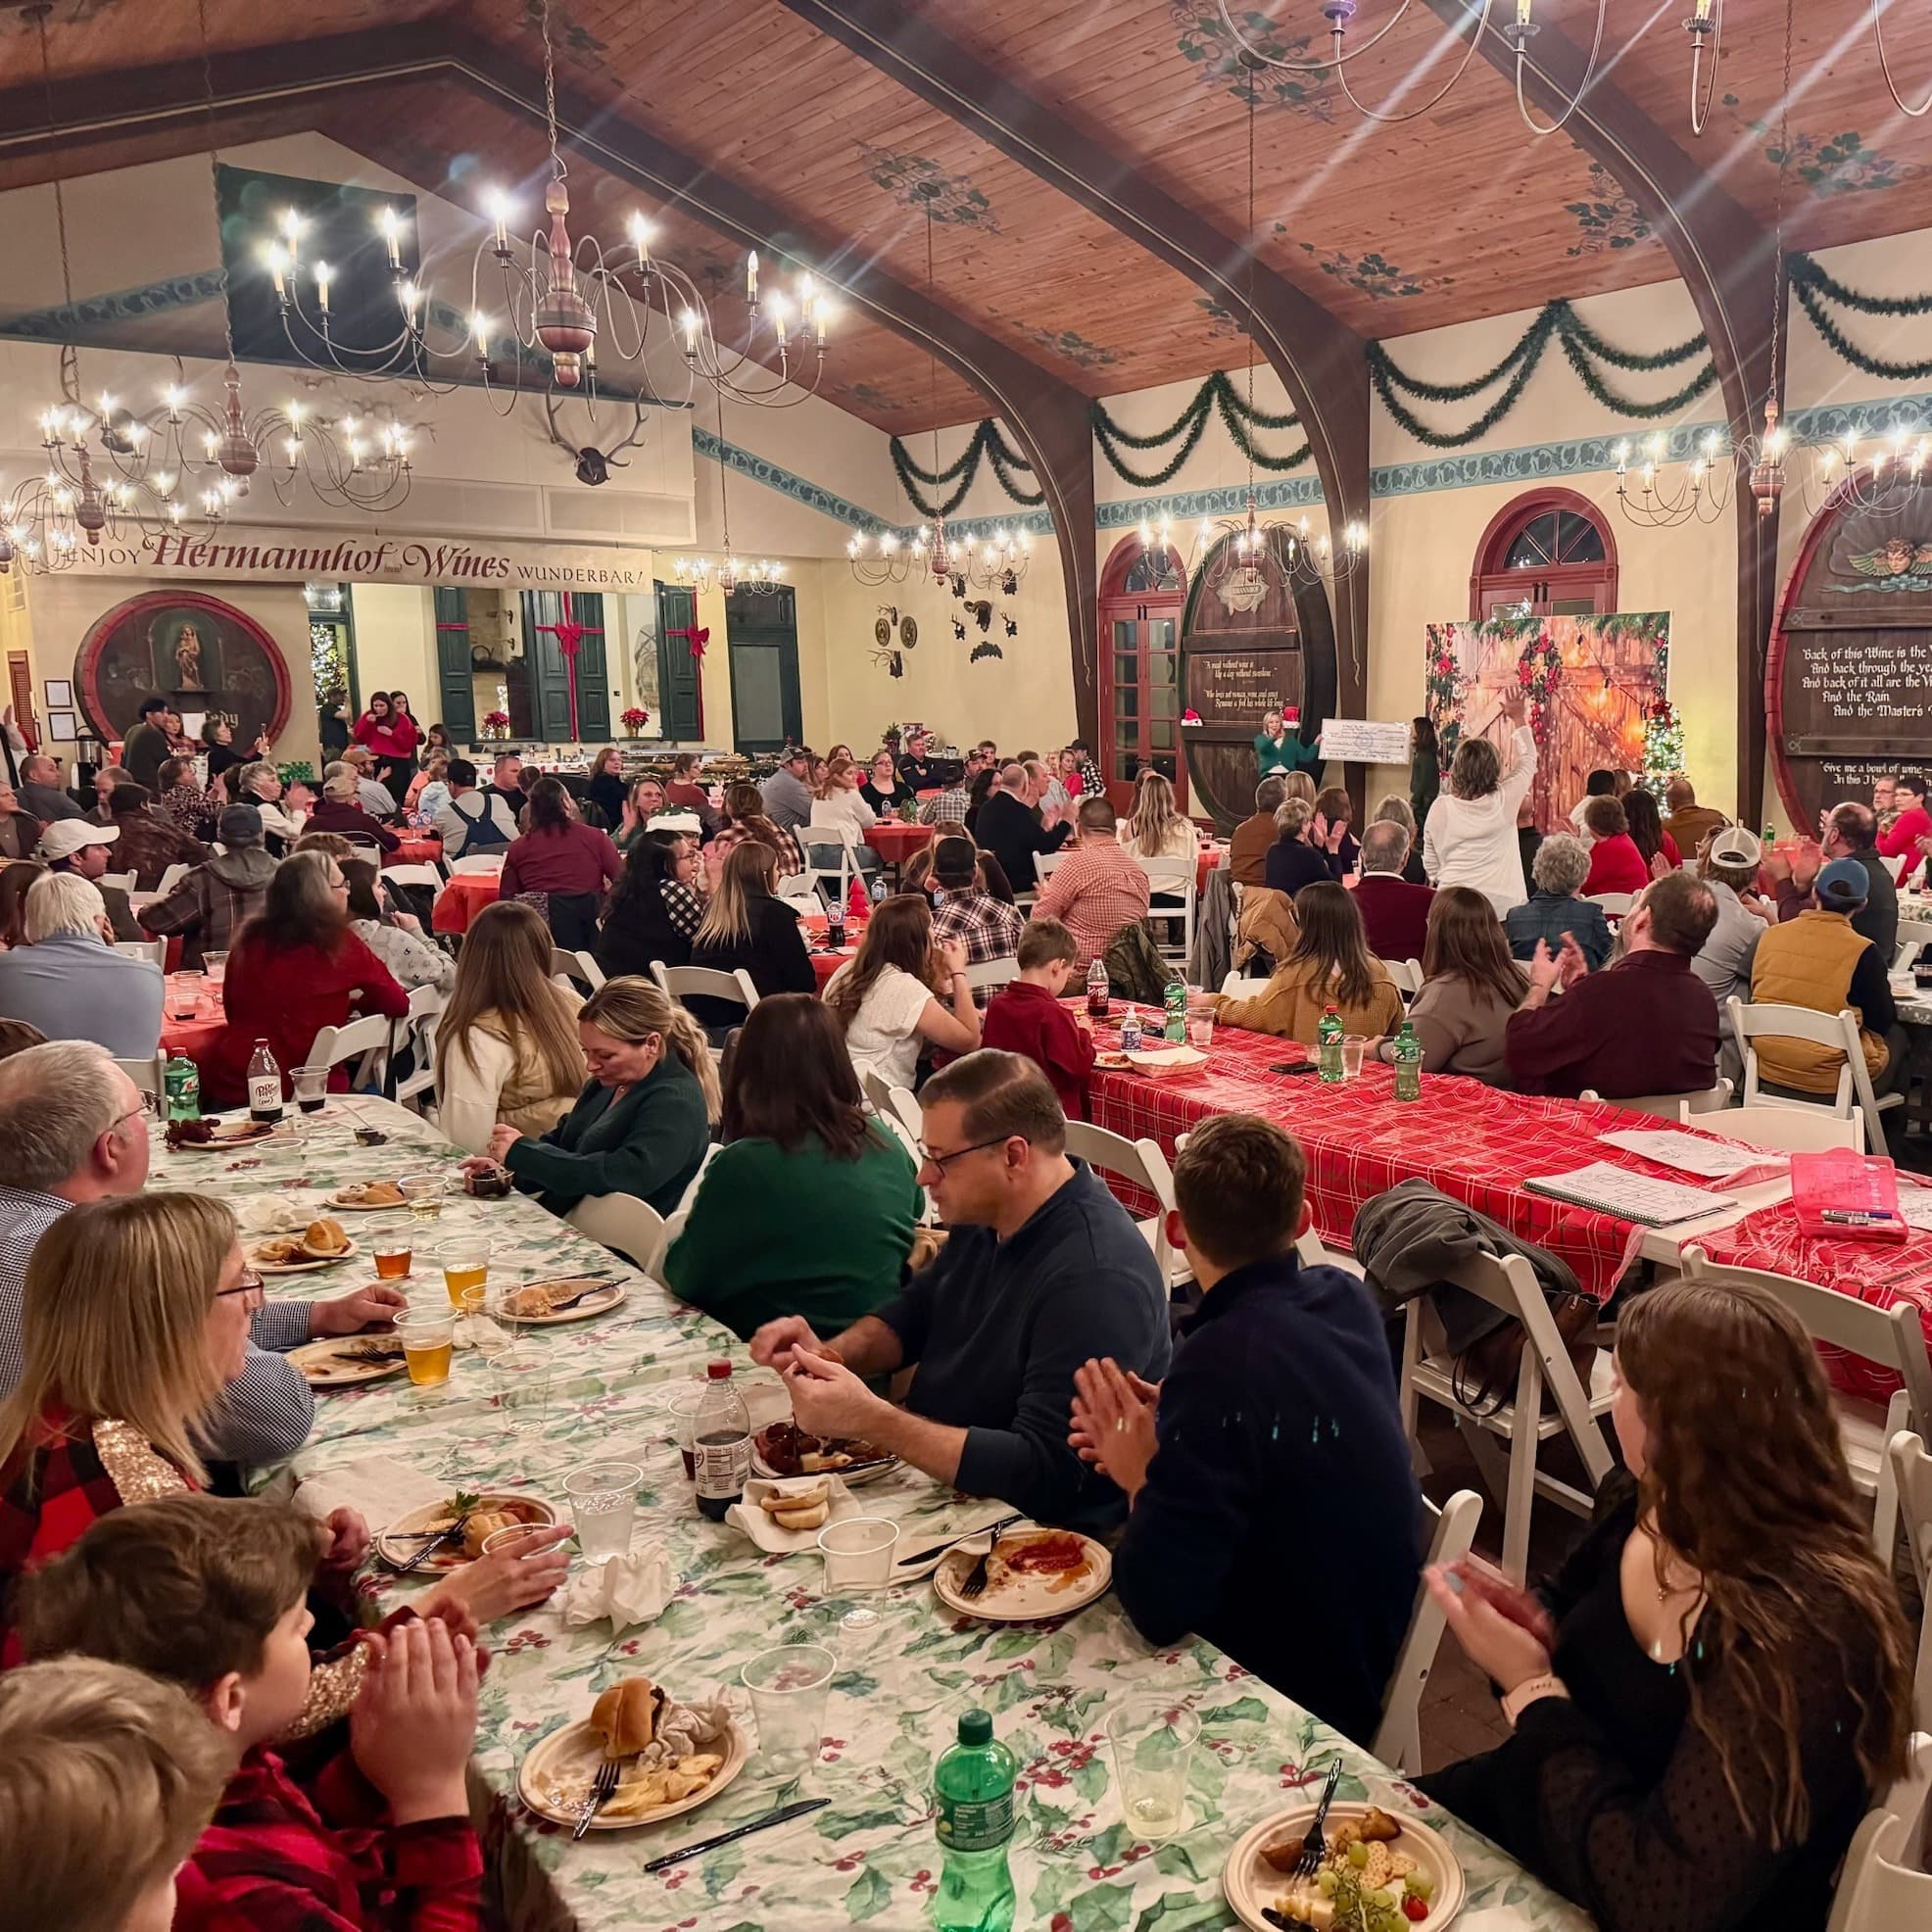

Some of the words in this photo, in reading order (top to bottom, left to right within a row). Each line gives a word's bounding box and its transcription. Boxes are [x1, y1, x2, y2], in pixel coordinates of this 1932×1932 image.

[67, 548, 140, 567] ENJOY
[141, 534, 397, 575] Hermannhof
[402, 543, 510, 579] Wines
[516, 564, 643, 584] WUNDERBAR!
[1803, 648, 1828, 660] Back
[1831, 648, 1842, 659] of
[1845, 647, 1862, 659] this
[1865, 647, 1894, 658] Wine
[1897, 647, 1906, 657] is
[1910, 645, 1926, 658] the
[1811, 663, 1829, 674] And
[1833, 662, 1857, 674] back
[1859, 661, 1896, 676] through
[1901, 659, 1915, 672] the
[1802, 677, 1820, 688] And
[1824, 676, 1847, 689] back
[1848, 677, 1860, 687] of
[1860, 678, 1867, 687] it
[1871, 674, 1882, 687] all
[1886, 678, 1901, 687] are
[1906, 674, 1920, 688] the
[1822, 691, 1842, 702] And
[1847, 690, 1861, 702] the
[1865, 691, 1890, 703] Rain
[1833, 704, 1854, 716] And
[1858, 703, 1873, 718] the
[1877, 704, 1923, 717] Master's
[204, 709, 239, 729] ady
[1866, 762, 1886, 773] bowl
[1889, 763, 1900, 773] of
[1834, 775, 1845, 784] In
[1847, 774, 1860, 784] this
[1863, 775, 1869, 784] I
